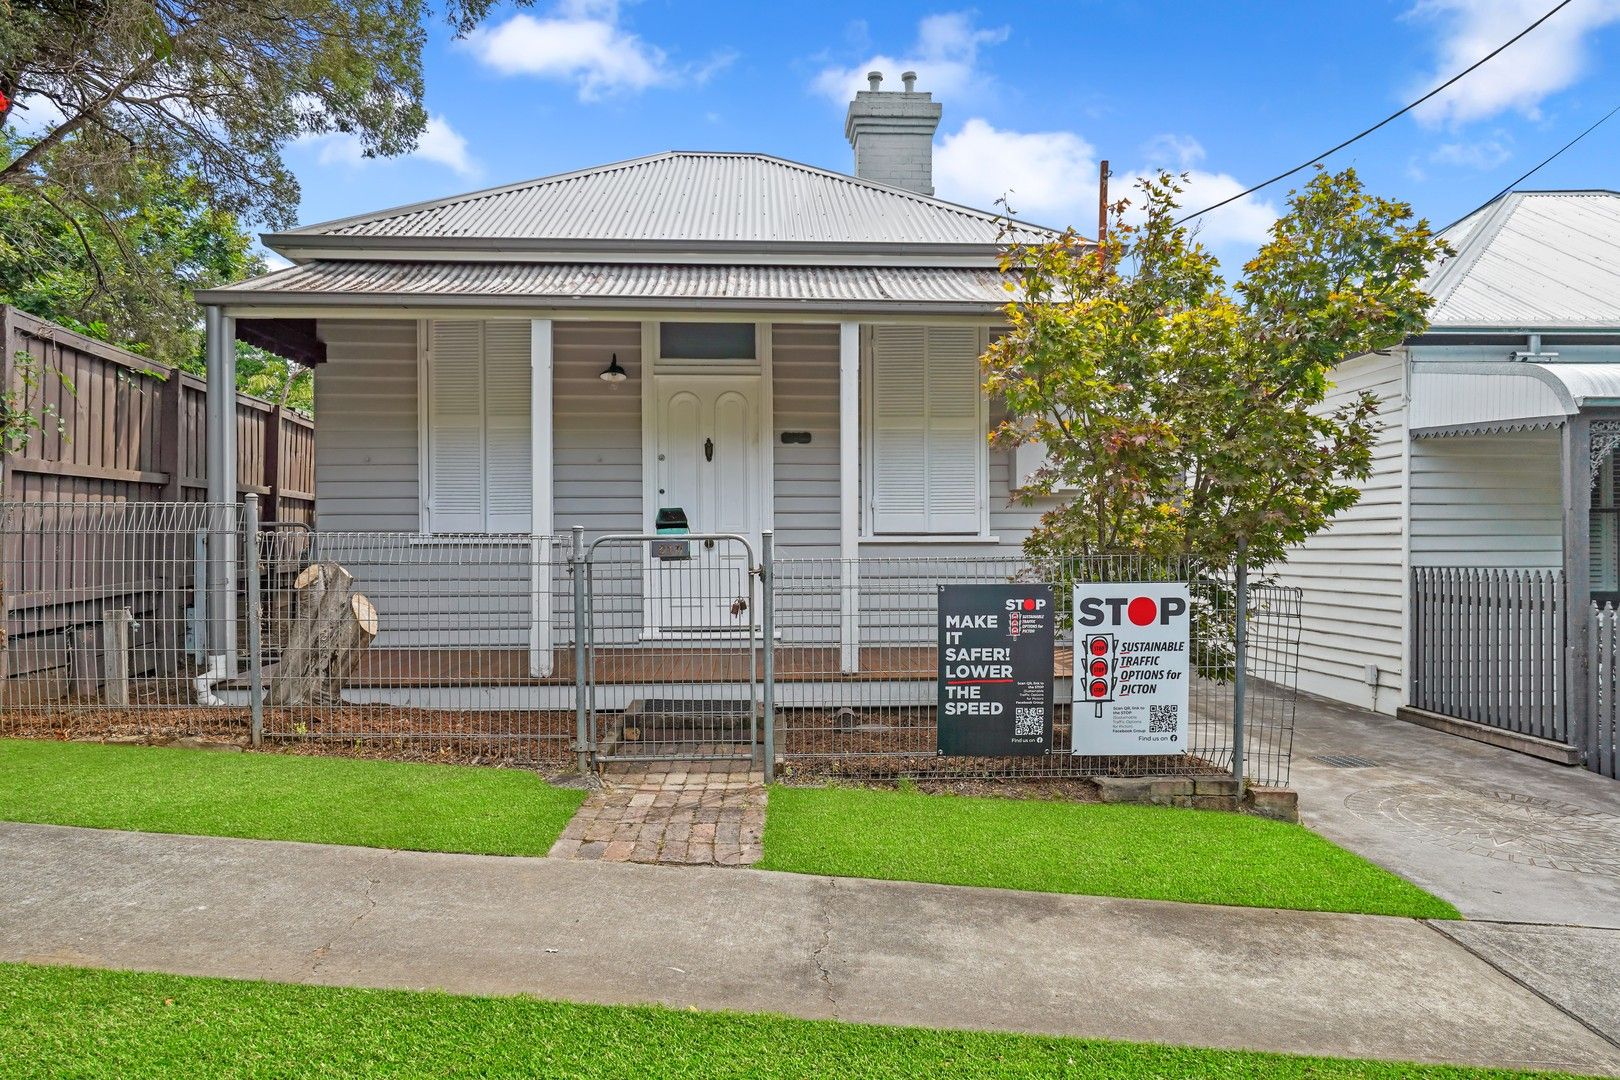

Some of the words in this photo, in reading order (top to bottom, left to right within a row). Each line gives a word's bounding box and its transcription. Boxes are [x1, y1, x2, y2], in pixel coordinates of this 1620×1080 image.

[1078, 596, 1186, 626] STOP
[946, 615, 998, 628] MAKE
[946, 632, 962, 644] IT
[1121, 641, 1184, 652] SUSTAINABLE
[946, 648, 1010, 661] SAFER!
[1121, 656, 1160, 666] TRAFFIC
[946, 665, 1013, 678] LOWER
[1121, 670, 1164, 680] OPTIONS
[1166, 670, 1182, 680] for
[945, 686, 980, 699] THE
[1121, 684, 1157, 694] PICTON
[945, 702, 1004, 715] SPEED
